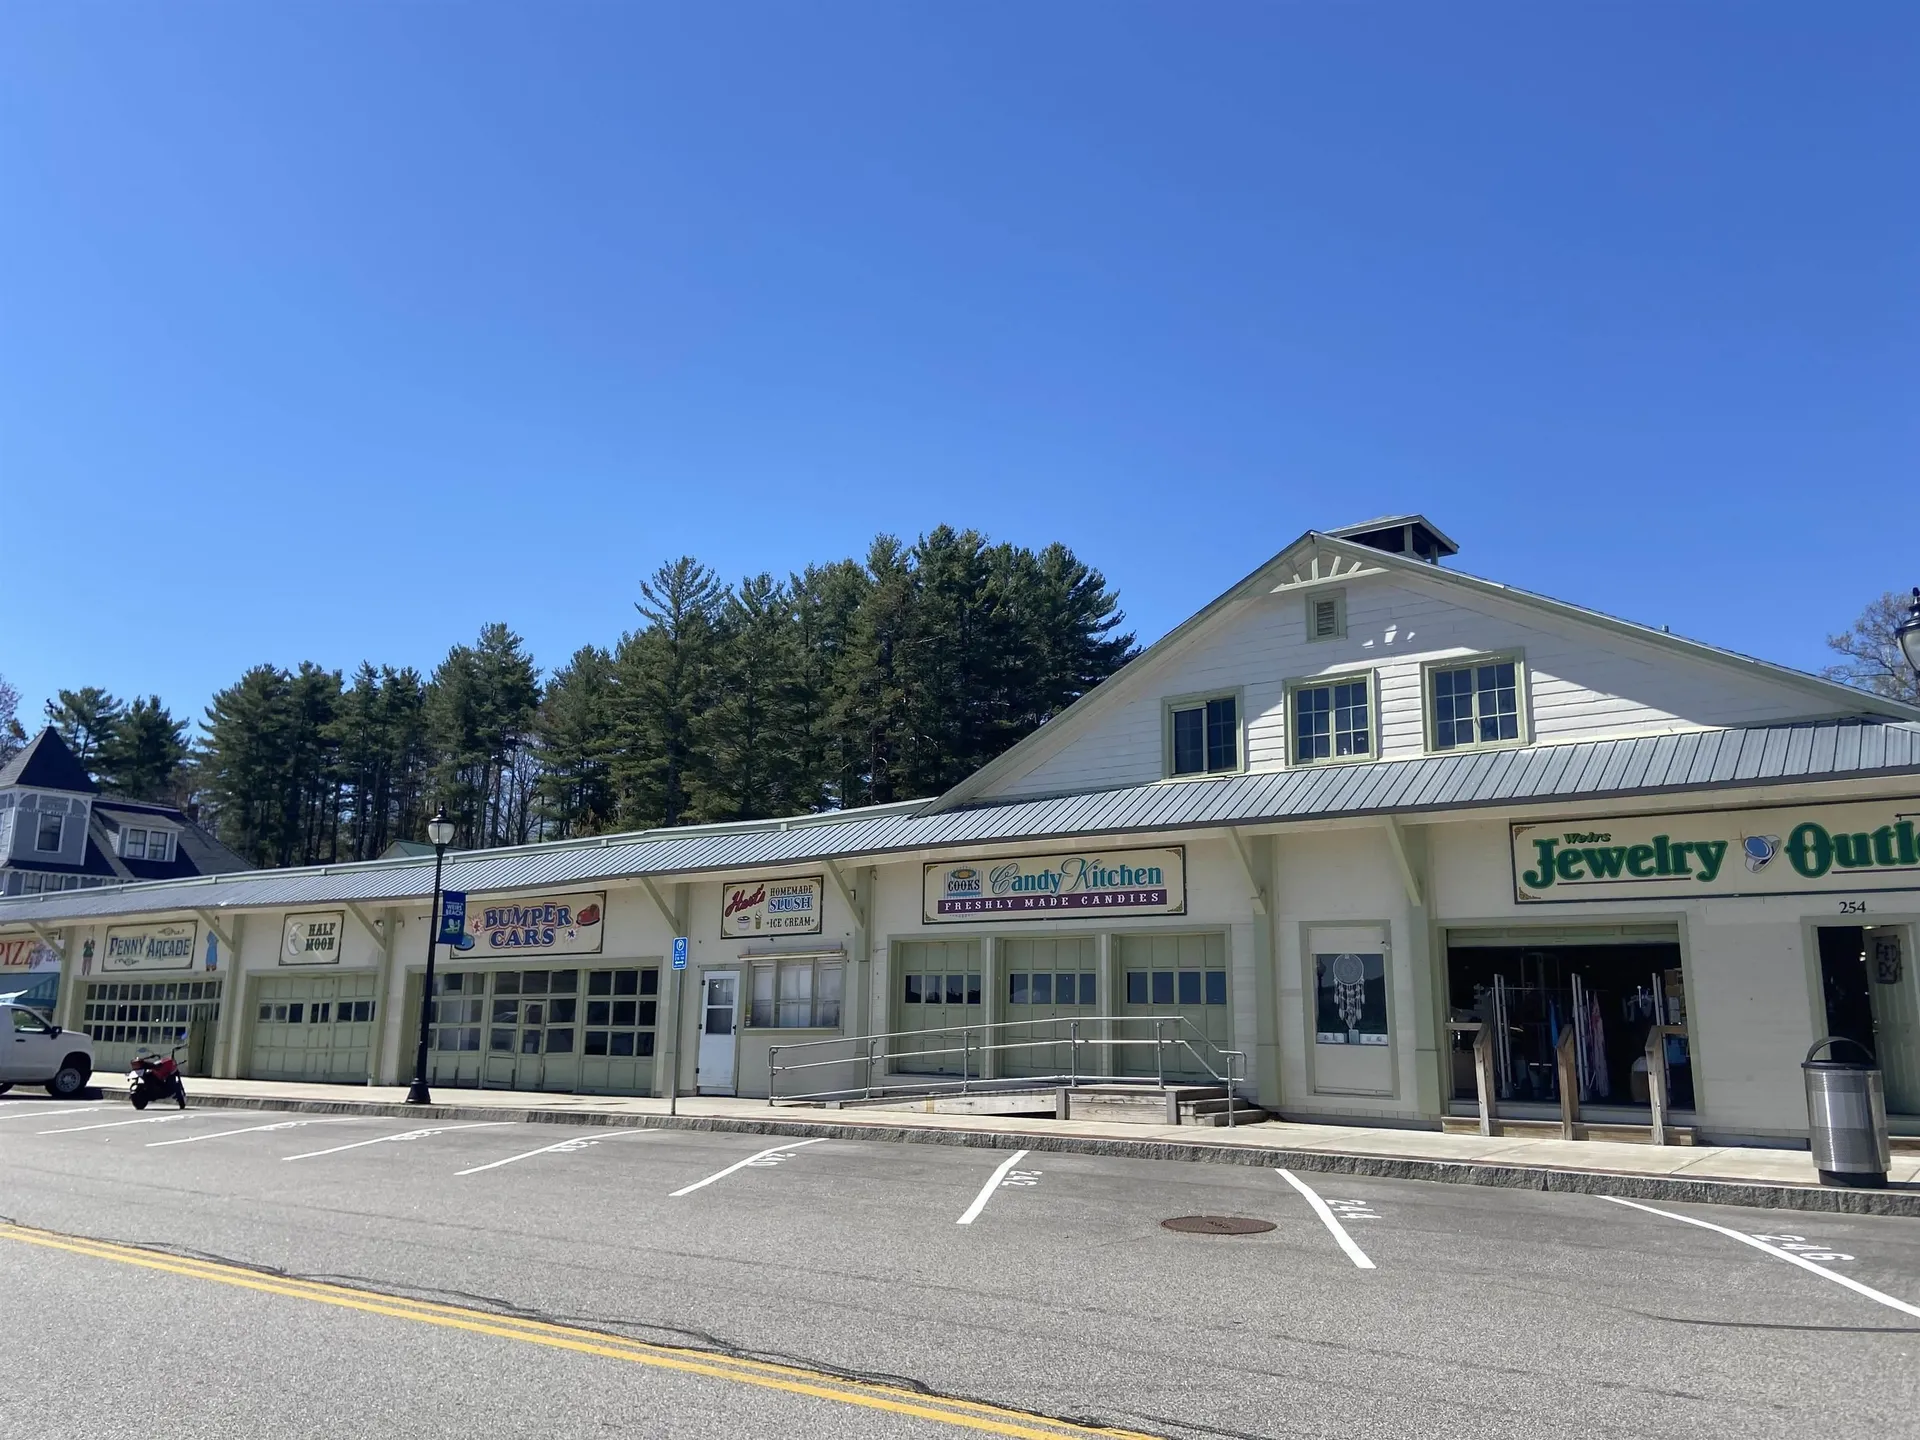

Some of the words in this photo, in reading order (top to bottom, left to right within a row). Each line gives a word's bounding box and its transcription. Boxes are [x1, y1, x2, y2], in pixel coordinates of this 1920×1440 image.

[1563, 832, 1612, 844] Weirs
[1784, 821, 1920, 878] Outl
[1522, 834, 1729, 889] Jewelry
[989, 862, 1063, 895] Candy
[1061, 857, 1162, 892] Kitchen
[770, 884, 814, 897] HOMEMADE
[947, 879, 981, 892] COOKS
[768, 896, 813, 912] SLUSH
[944, 899, 1014, 911] FRESHLY
[1024, 896, 1069, 908] MADE
[1081, 892, 1159, 905] CANDIES
[1838, 901, 1867, 914] 254
[484, 903, 573, 931] BUMPER
[769, 918, 782, 928] ICE
[784, 916, 812, 928] CREAM
[308, 922, 336, 937] HALF
[489, 926, 557, 949] CARS
[108, 935, 147, 957] PENNY
[146, 938, 192, 959] ARCADE
[304, 937, 335, 951] MOON
[1001, 1170, 1043, 1186] 242
[1325, 1199, 1382, 1219] 244
[1751, 1233, 1856, 1262] 246
